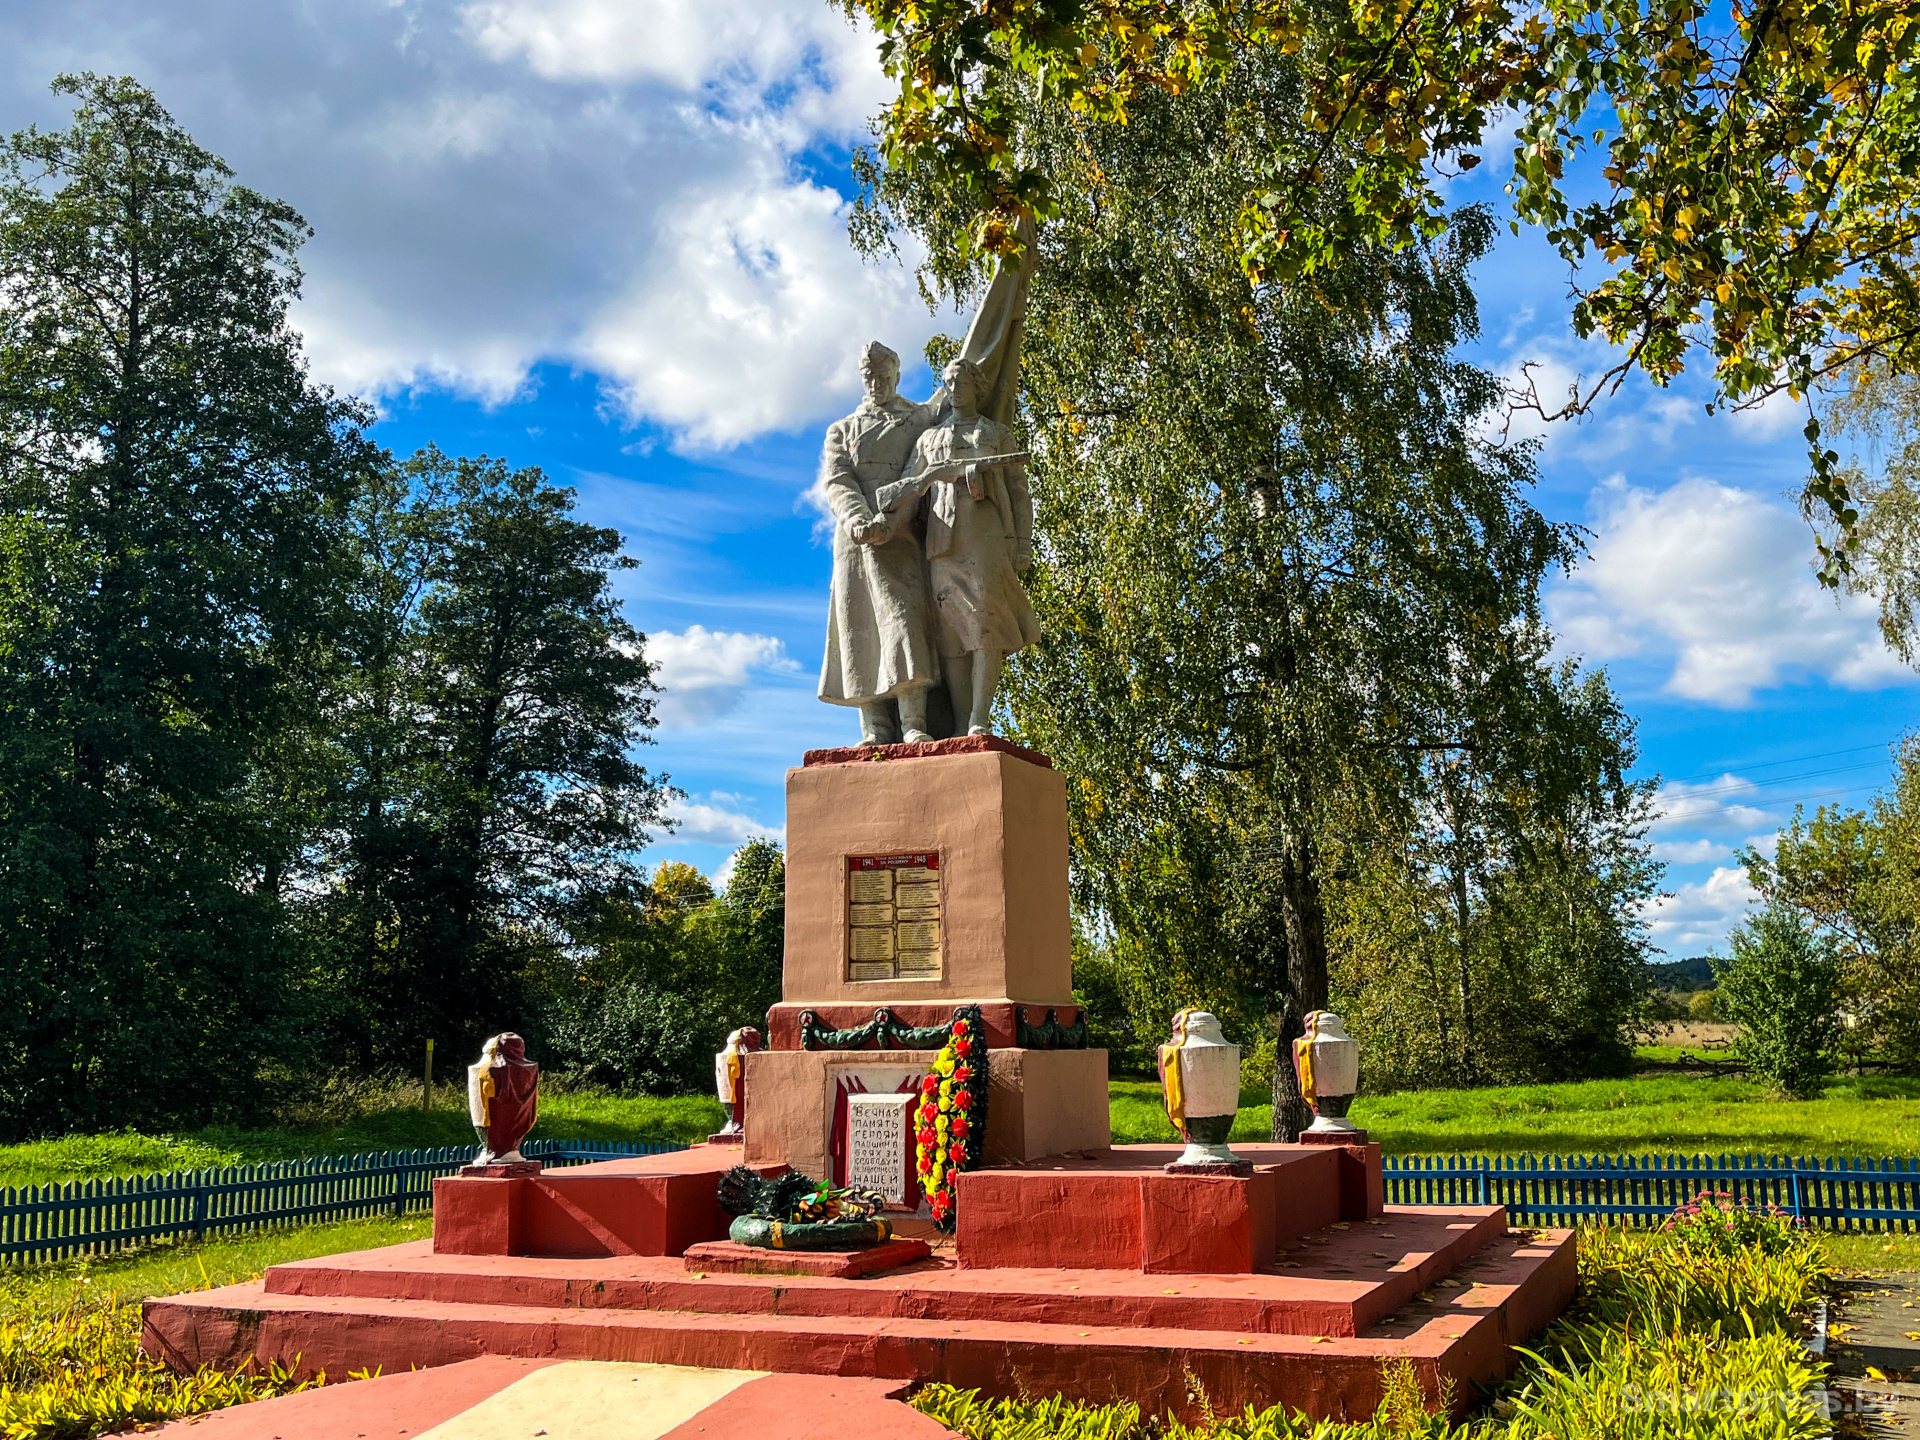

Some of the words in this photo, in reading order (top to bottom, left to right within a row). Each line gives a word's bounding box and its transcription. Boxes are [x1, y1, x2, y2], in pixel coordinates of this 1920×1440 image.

[862, 858, 874, 866] 1941
[913, 855, 926, 864] 1945
[855, 1106, 899, 1118] ВЕЧНАЯ
[855, 1119, 899, 1129] ПАМЯТЬ
[855, 1130, 899, 1140] ГЕРОЯМ
[855, 1148, 882, 1157] БОЯХ
[855, 1157, 892, 1165] СВОБОДУ
[854, 1184, 898, 1197] РОИНЫ
